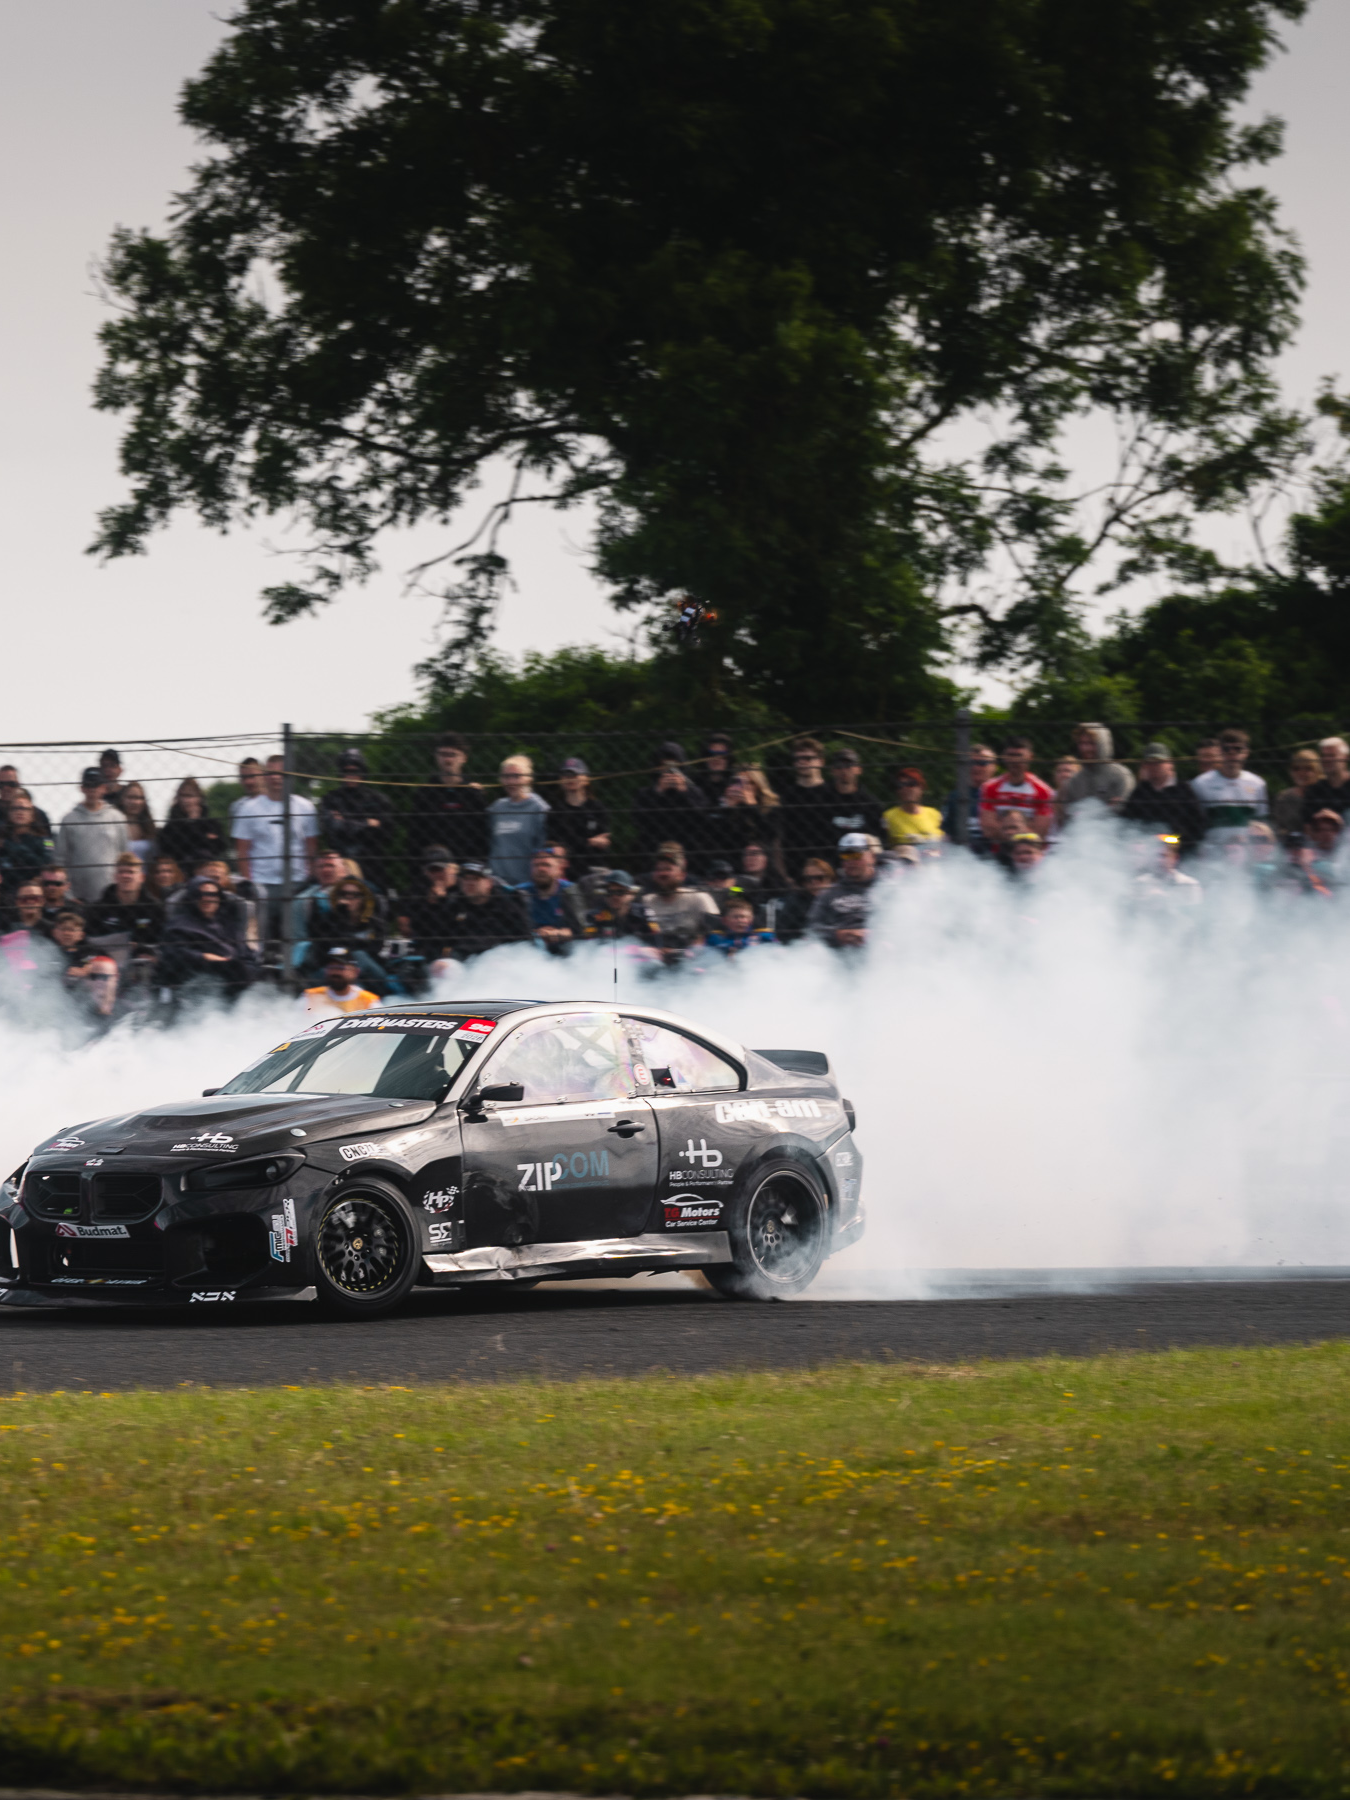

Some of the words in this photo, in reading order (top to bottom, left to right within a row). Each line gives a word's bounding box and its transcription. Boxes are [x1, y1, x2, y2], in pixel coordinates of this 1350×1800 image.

[681, 1206, 721, 1217] Motors
[677, 1219, 697, 1227] Service
[698, 1218, 718, 1226] Center
[76, 1226, 127, 1236] Budmat.
